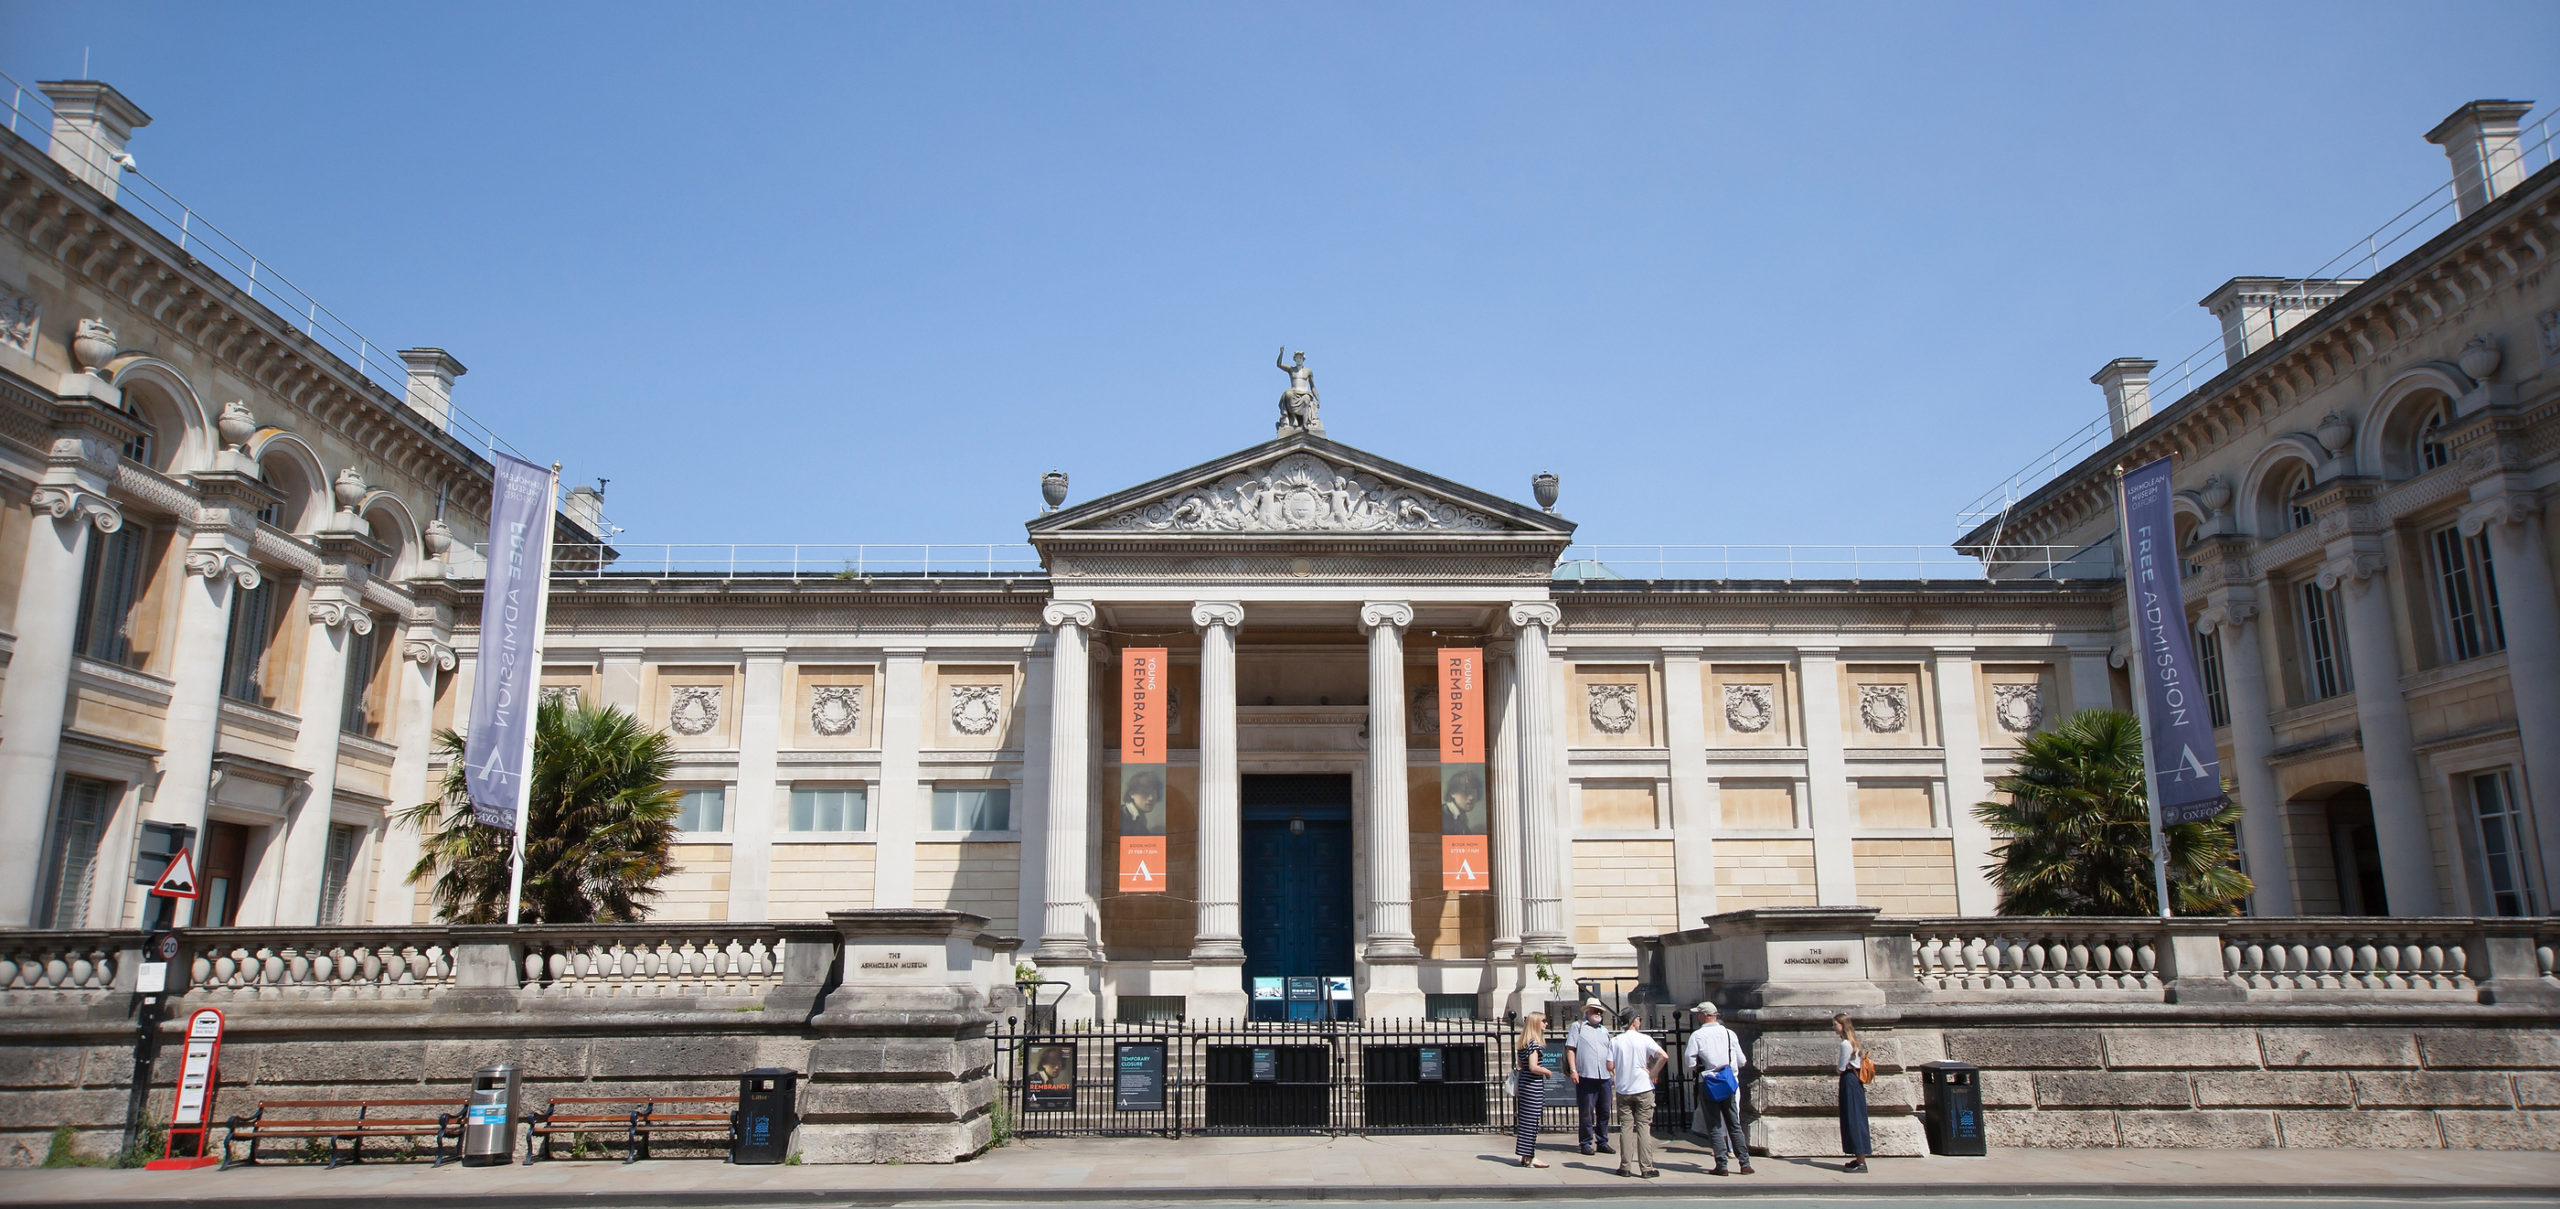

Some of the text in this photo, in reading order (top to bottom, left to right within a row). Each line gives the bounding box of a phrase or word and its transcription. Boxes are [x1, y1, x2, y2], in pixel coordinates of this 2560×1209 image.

[2127, 474, 2165, 496] ASHMOLEAN
[2132, 486, 2158, 502] MUSEUM
[2132, 495, 2158, 510] OXFORD
[2138, 525, 2189, 727] FREE ADMISSION
[1148, 657, 1156, 691] YOUNG
[1463, 657, 1473, 691] YOUNG
[1133, 657, 1146, 757] REMBRANDT
[1449, 657, 1464, 757] REMBRANDT
[164, 942, 177, 953] 20
